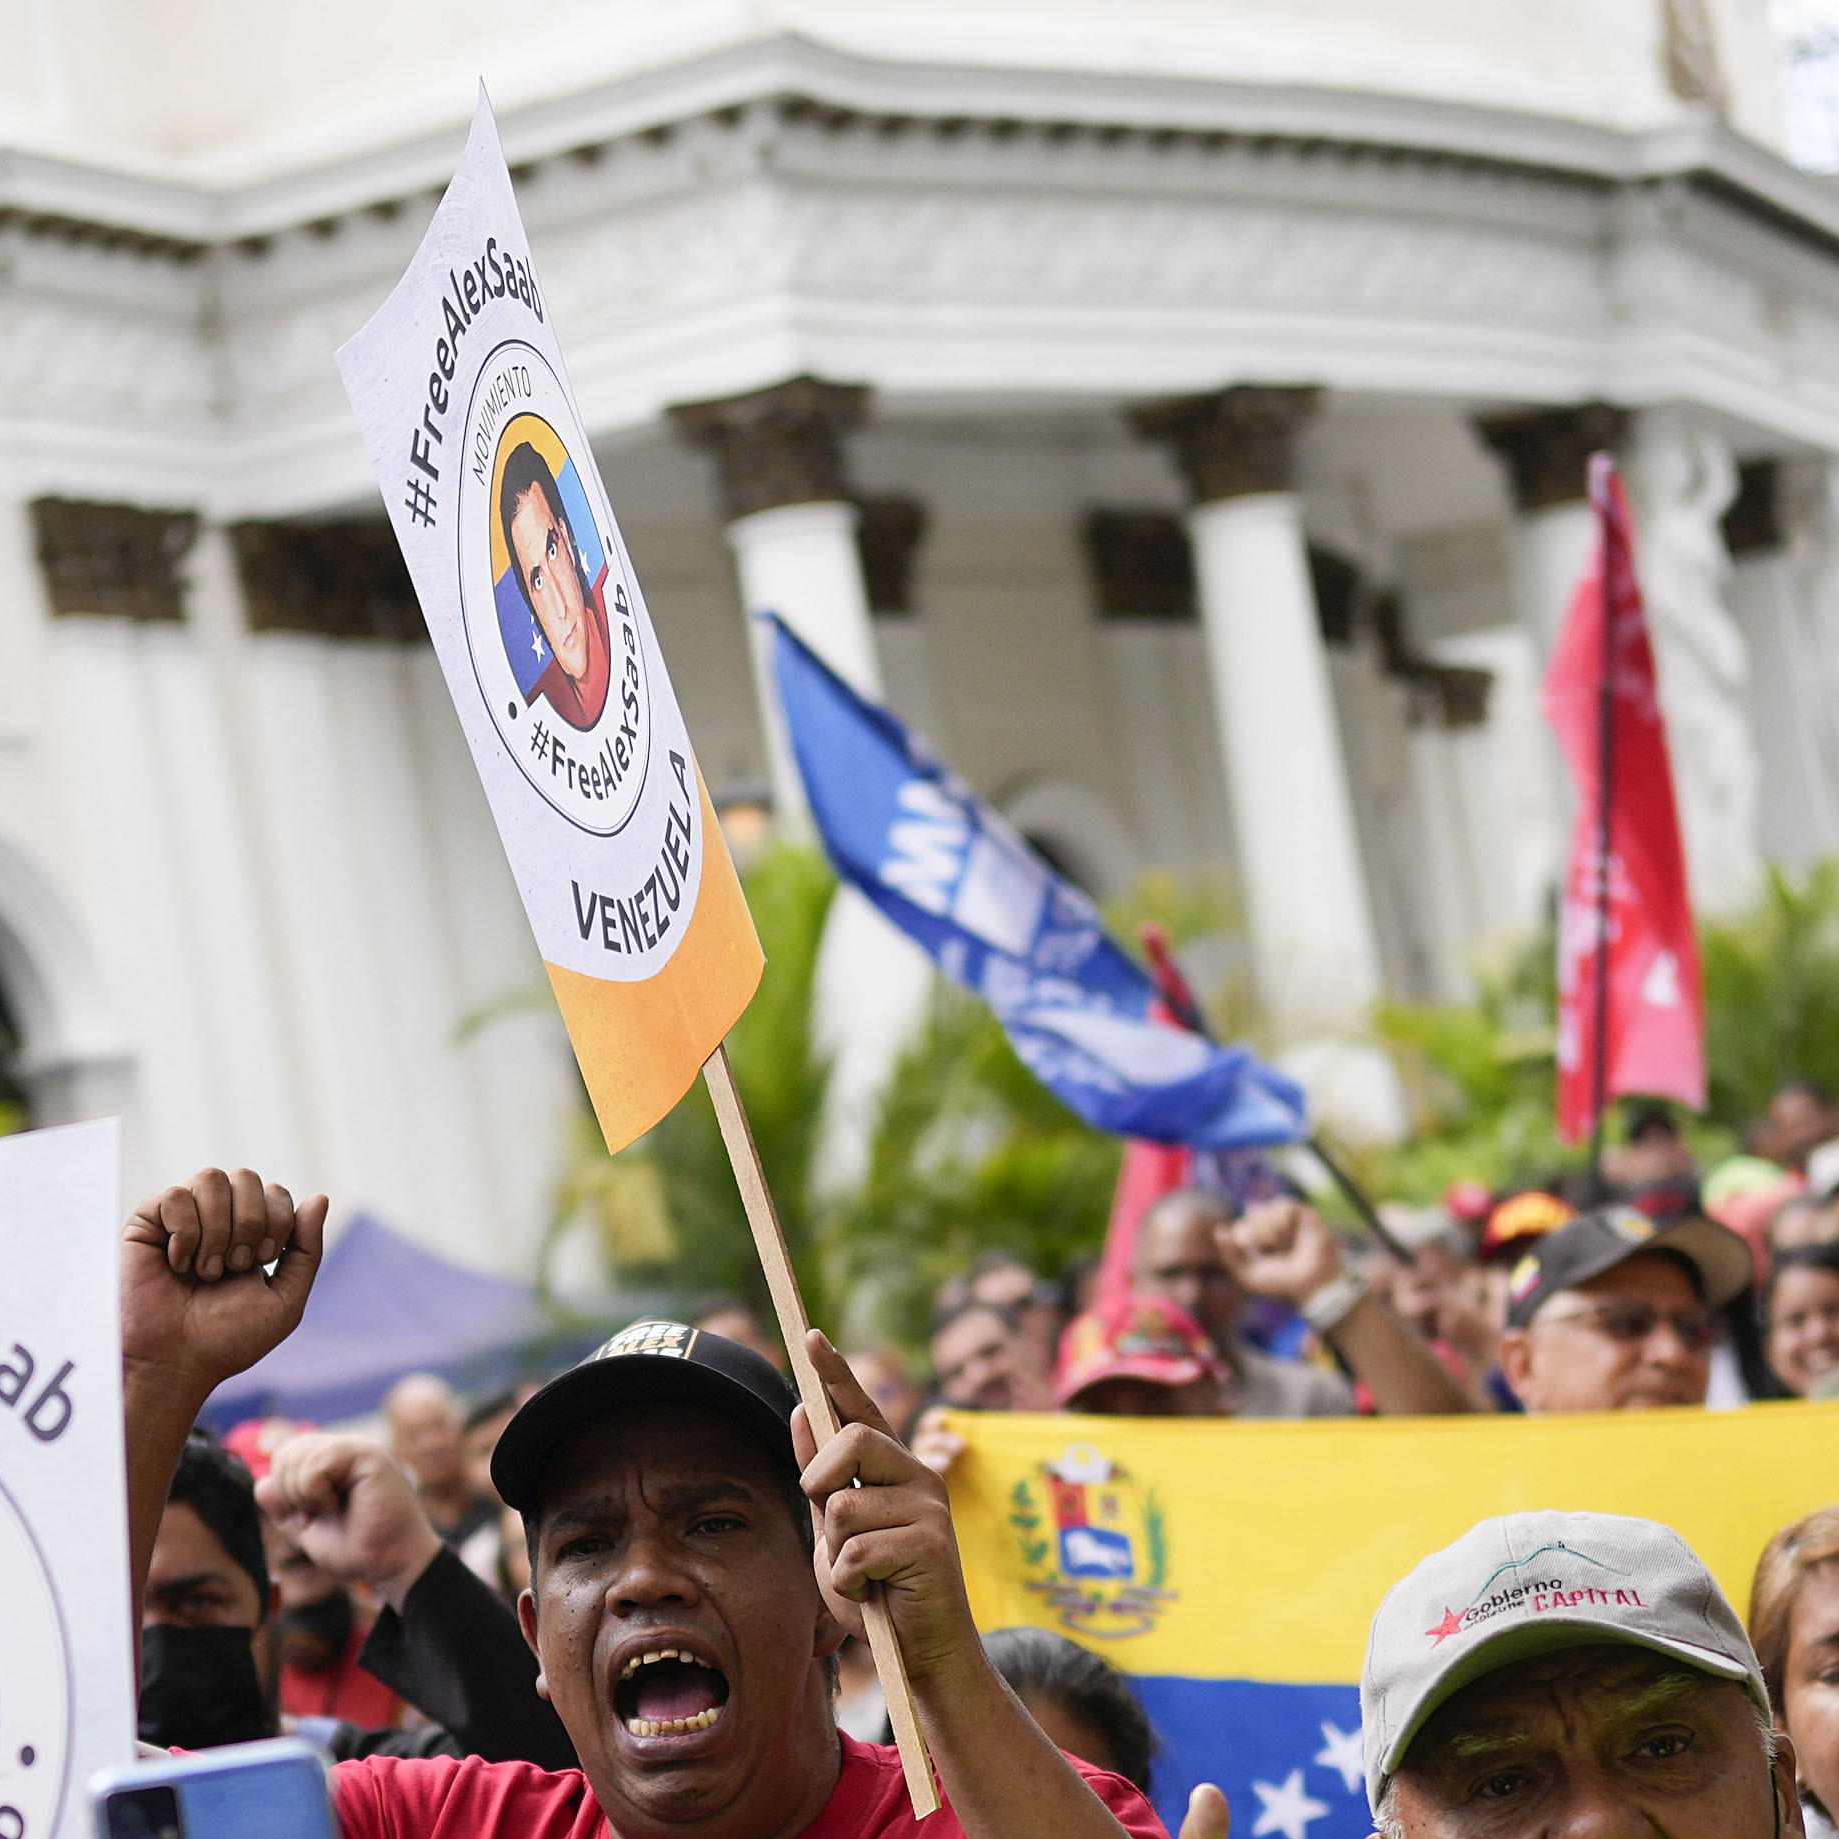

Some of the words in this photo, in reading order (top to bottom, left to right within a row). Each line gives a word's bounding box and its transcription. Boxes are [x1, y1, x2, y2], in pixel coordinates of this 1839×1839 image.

[405, 237, 544, 528] #FreeAlexSaab
[472, 366, 532, 487] MOVIMIENTO
[530, 583, 640, 801] #FreeAlexSaab
[571, 748, 692, 955] VENEZUELA
[605, 1335, 685, 1358] ALEX
[1532, 1588, 1649, 1613] CAPITAL
